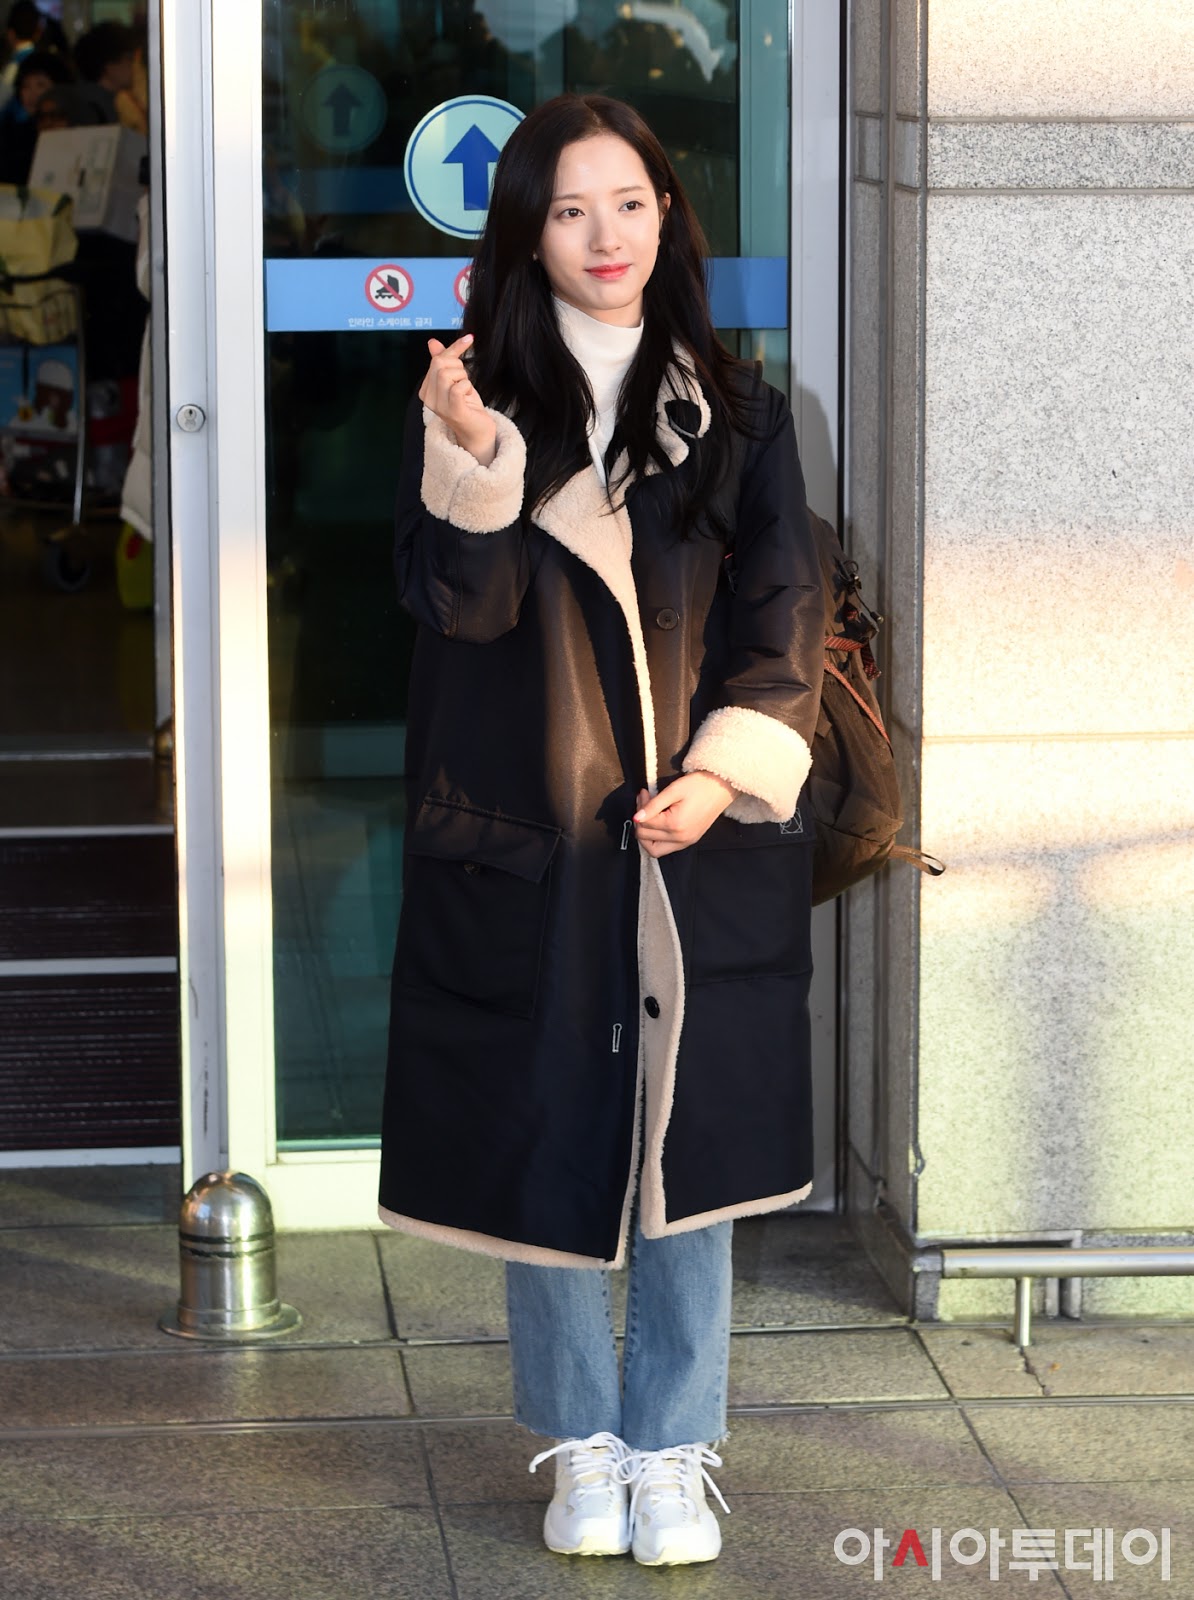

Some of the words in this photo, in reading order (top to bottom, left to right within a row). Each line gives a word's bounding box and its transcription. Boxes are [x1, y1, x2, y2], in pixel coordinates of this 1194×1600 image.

[348, 317, 374, 327] 인라인
[377, 317, 412, 327] 스케이트
[415, 317, 433, 327] 금지
